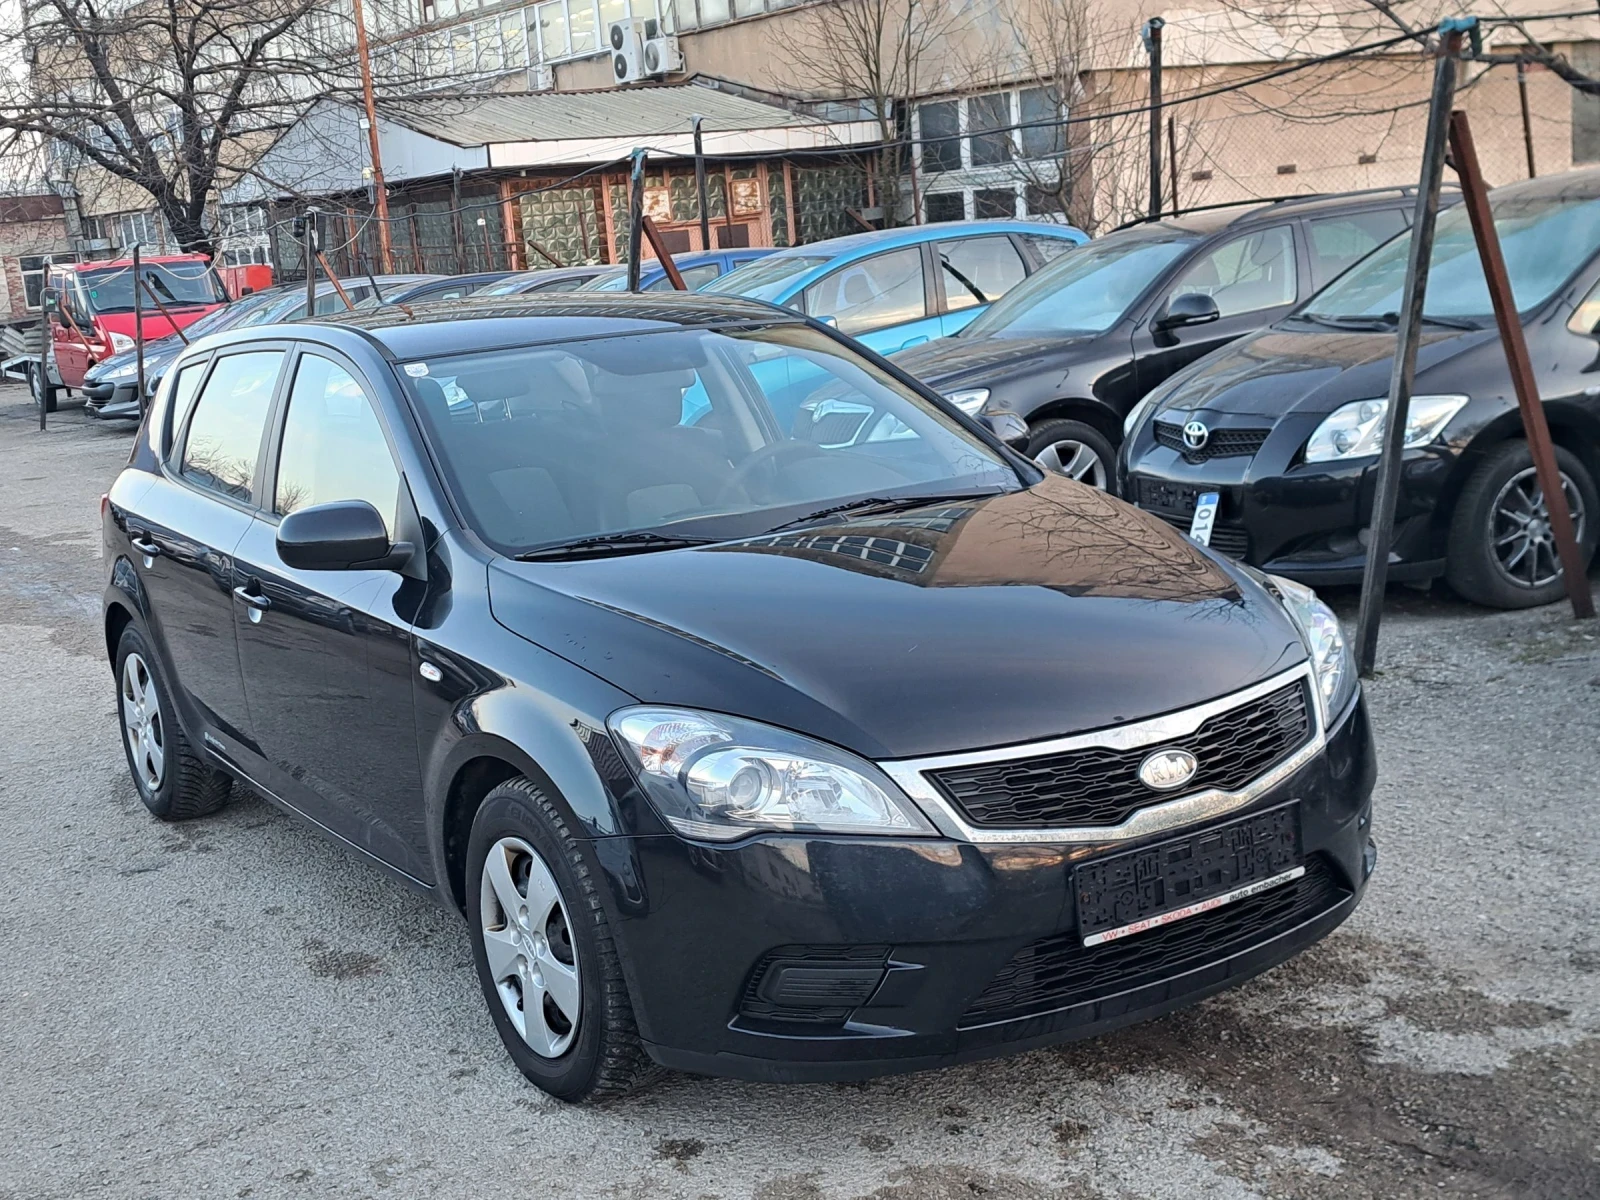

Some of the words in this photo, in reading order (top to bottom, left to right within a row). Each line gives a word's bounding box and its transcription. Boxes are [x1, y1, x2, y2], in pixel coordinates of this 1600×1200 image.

[1101, 929, 1119, 941] VW
[1127, 919, 1152, 934] SEAT
[1161, 907, 1193, 924] SKODA
[1201, 898, 1222, 911] AUDI
[1229, 889, 1249, 901] auto
[1250, 872, 1293, 894] embacher
